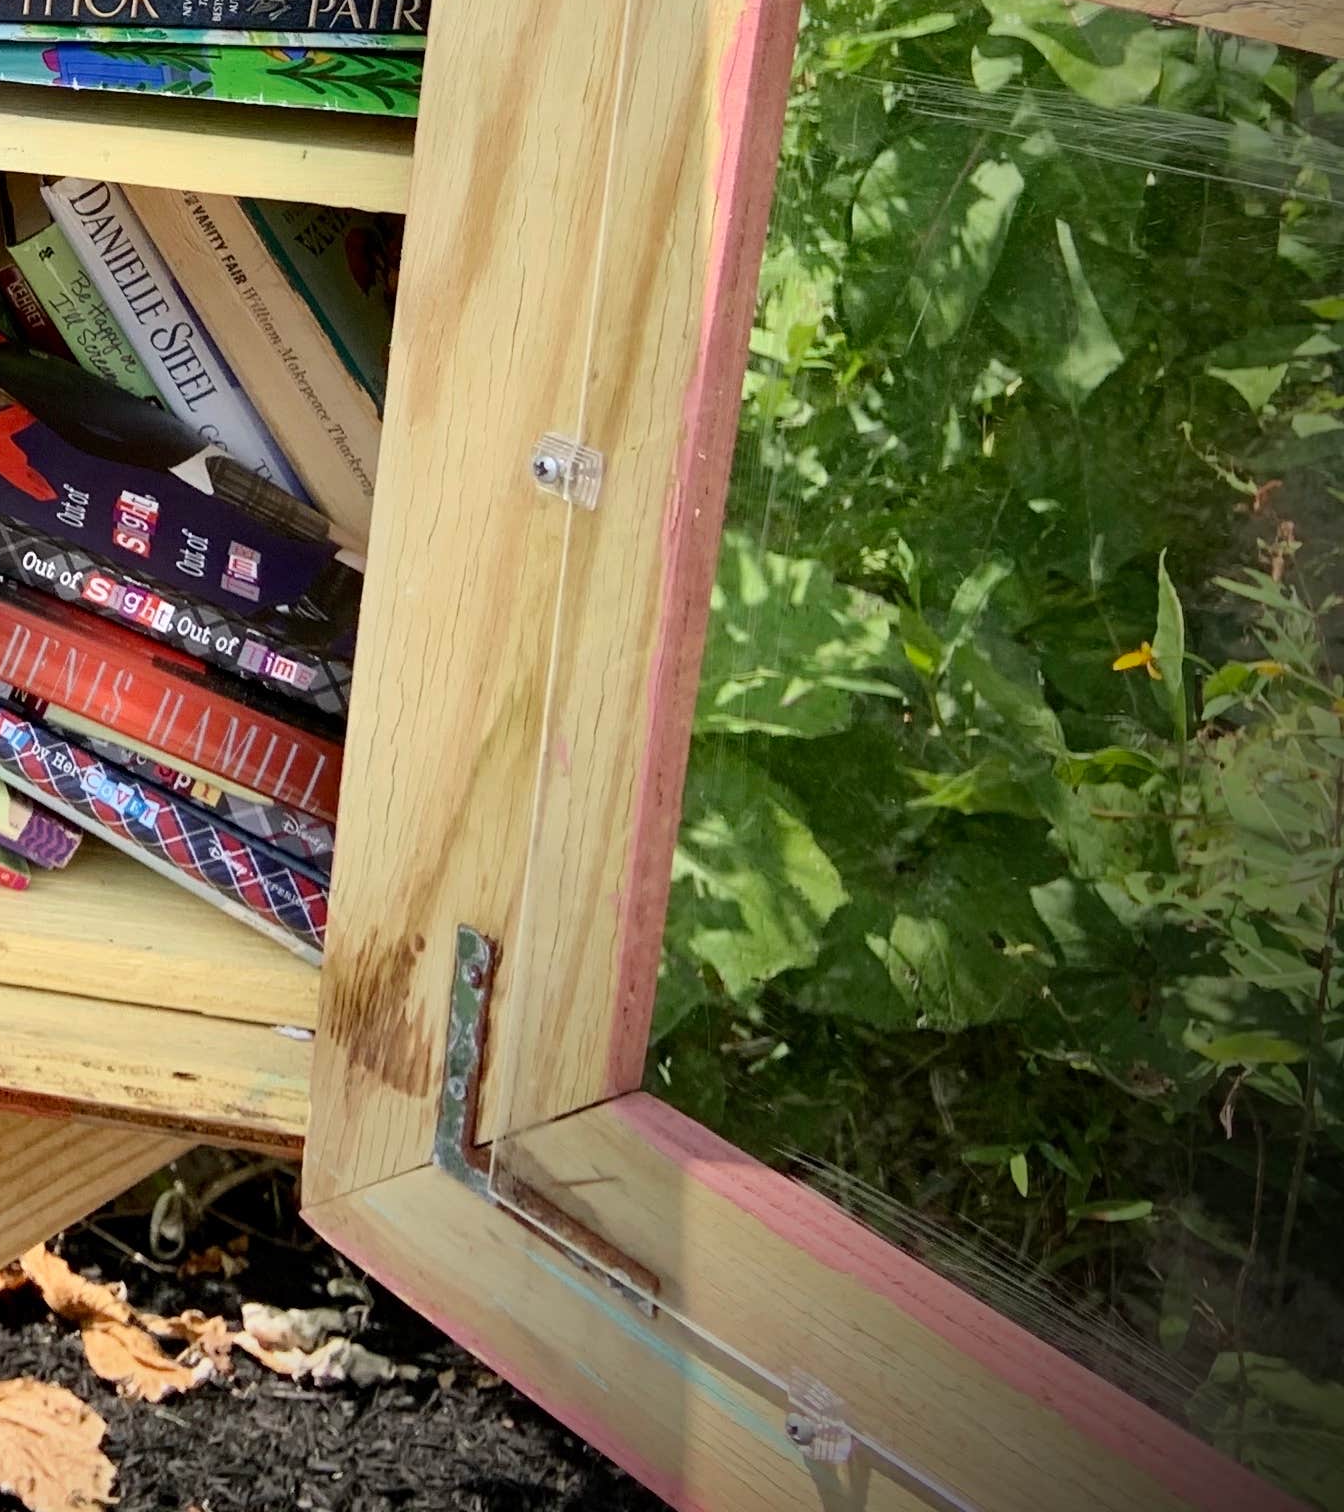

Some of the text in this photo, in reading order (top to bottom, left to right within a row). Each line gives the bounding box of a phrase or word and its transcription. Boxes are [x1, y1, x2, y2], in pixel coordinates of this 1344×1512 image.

[69, 181, 218, 412] DANIELLE STEEL
[193, 208, 248, 285] VANITY FAIR
[22, 551, 56, 580] Out
[60, 566, 83, 585] of
[178, 617, 213, 646] Out
[216, 629, 240, 657] of
[31, 743, 50, 761] by
[52, 751, 80, 776] Her
[148, 688, 326, 809] HAMILL
